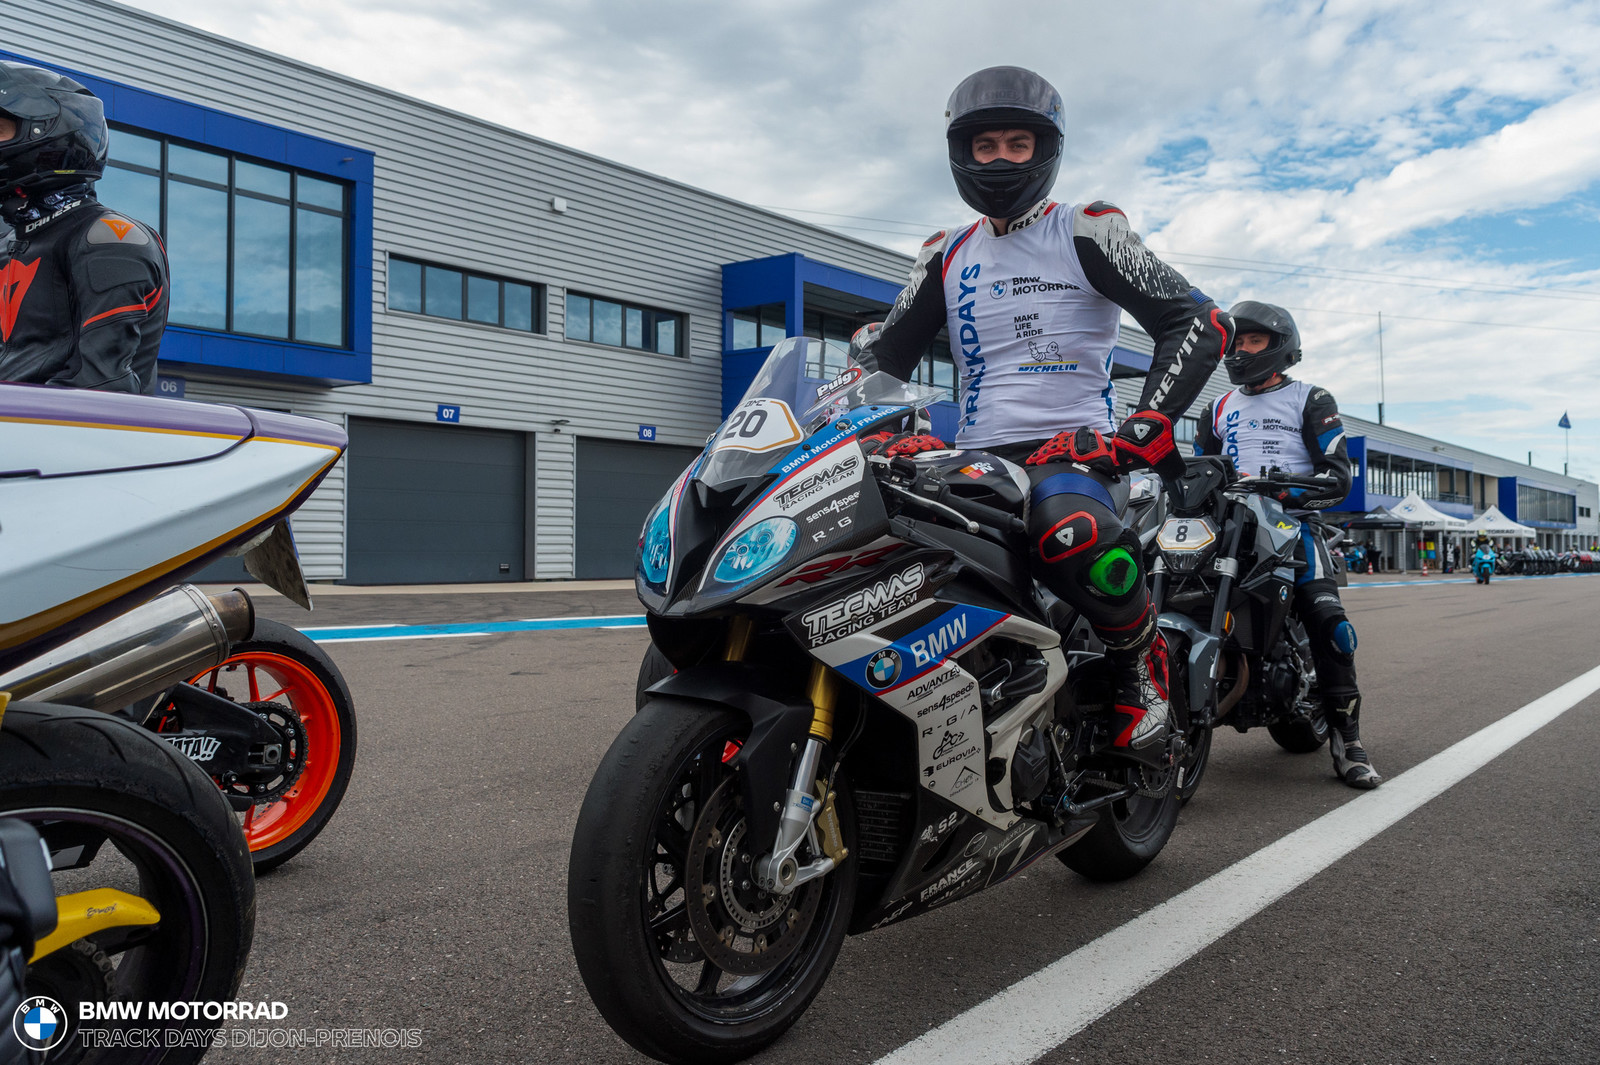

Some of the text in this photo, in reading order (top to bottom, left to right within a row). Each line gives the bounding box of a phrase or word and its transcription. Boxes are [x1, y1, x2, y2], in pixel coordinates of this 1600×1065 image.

[1012, 277, 1041, 295] BMW
[1014, 313, 1039, 323] MAKE
[1015, 322, 1032, 331] LIFE
[1016, 329, 1044, 339] A RIDE
[1018, 363, 1078, 373] MICHELIN
[1149, 316, 1205, 411] REV'IT!
[161, 380, 178, 393] 06
[816, 374, 852, 399] Puig
[442, 408, 455, 419] 07
[722, 409, 768, 439] 20
[643, 428, 653, 438] 08
[781, 405, 901, 474] BMW Motorrad FRANCE
[773, 455, 859, 508] TECMAS
[782, 486, 823, 512] RACING
[827, 470, 855, 486] TEAM
[806, 490, 861, 523] sens4spee
[1175, 525, 1188, 542] 8
[802, 562, 925, 640] TECMAS
[811, 592, 918, 648] RACING TEAM
[910, 613, 967, 669] BMW
[917, 682, 974, 718] sens4speed
[936, 746, 976, 771] EUROVIA
[920, 858, 976, 902] FRANCE
